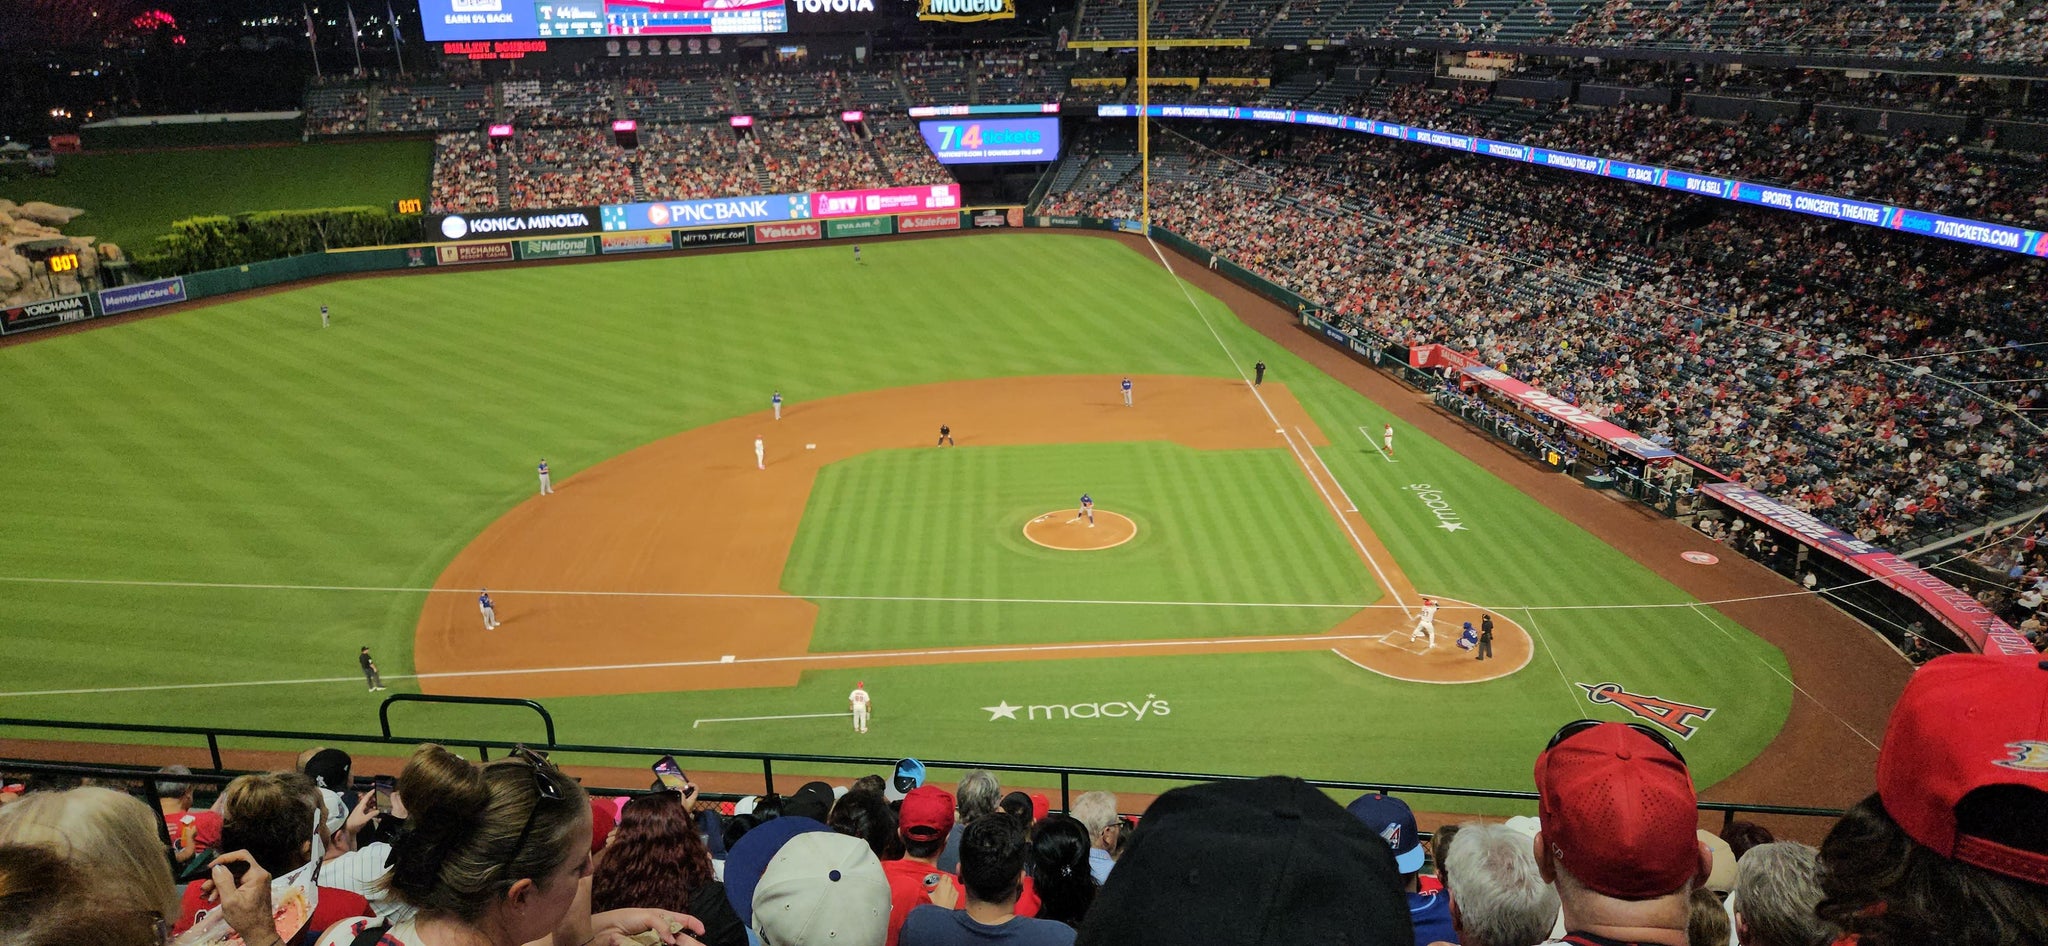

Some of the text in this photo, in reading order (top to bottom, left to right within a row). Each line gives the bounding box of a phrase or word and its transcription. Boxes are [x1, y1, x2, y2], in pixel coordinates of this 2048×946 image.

[794, 0, 874, 13] TOYOTA
[1686, 178, 1701, 190] BUY
[1706, 181, 1722, 195] SELL
[670, 200, 768, 222] PNC BANK
[1761, 190, 1879, 223] SPORTS, CONCERTS, THEATRE
[470, 217, 527, 234] KONICA
[528, 213, 589, 230] MINOLTA
[682, 231, 746, 243] NITTO TIRE.COM
[760, 225, 817, 239] Yakult
[460, 245, 508, 255] PECHANGA
[541, 239, 588, 251] National
[51, 253, 79, 272] 0:07
[105, 290, 168, 306] MemorialCare
[25, 298, 83, 317] YOKOHAMA
[59, 309, 85, 322] TIRES
[1028, 693, 1171, 721] macy's
